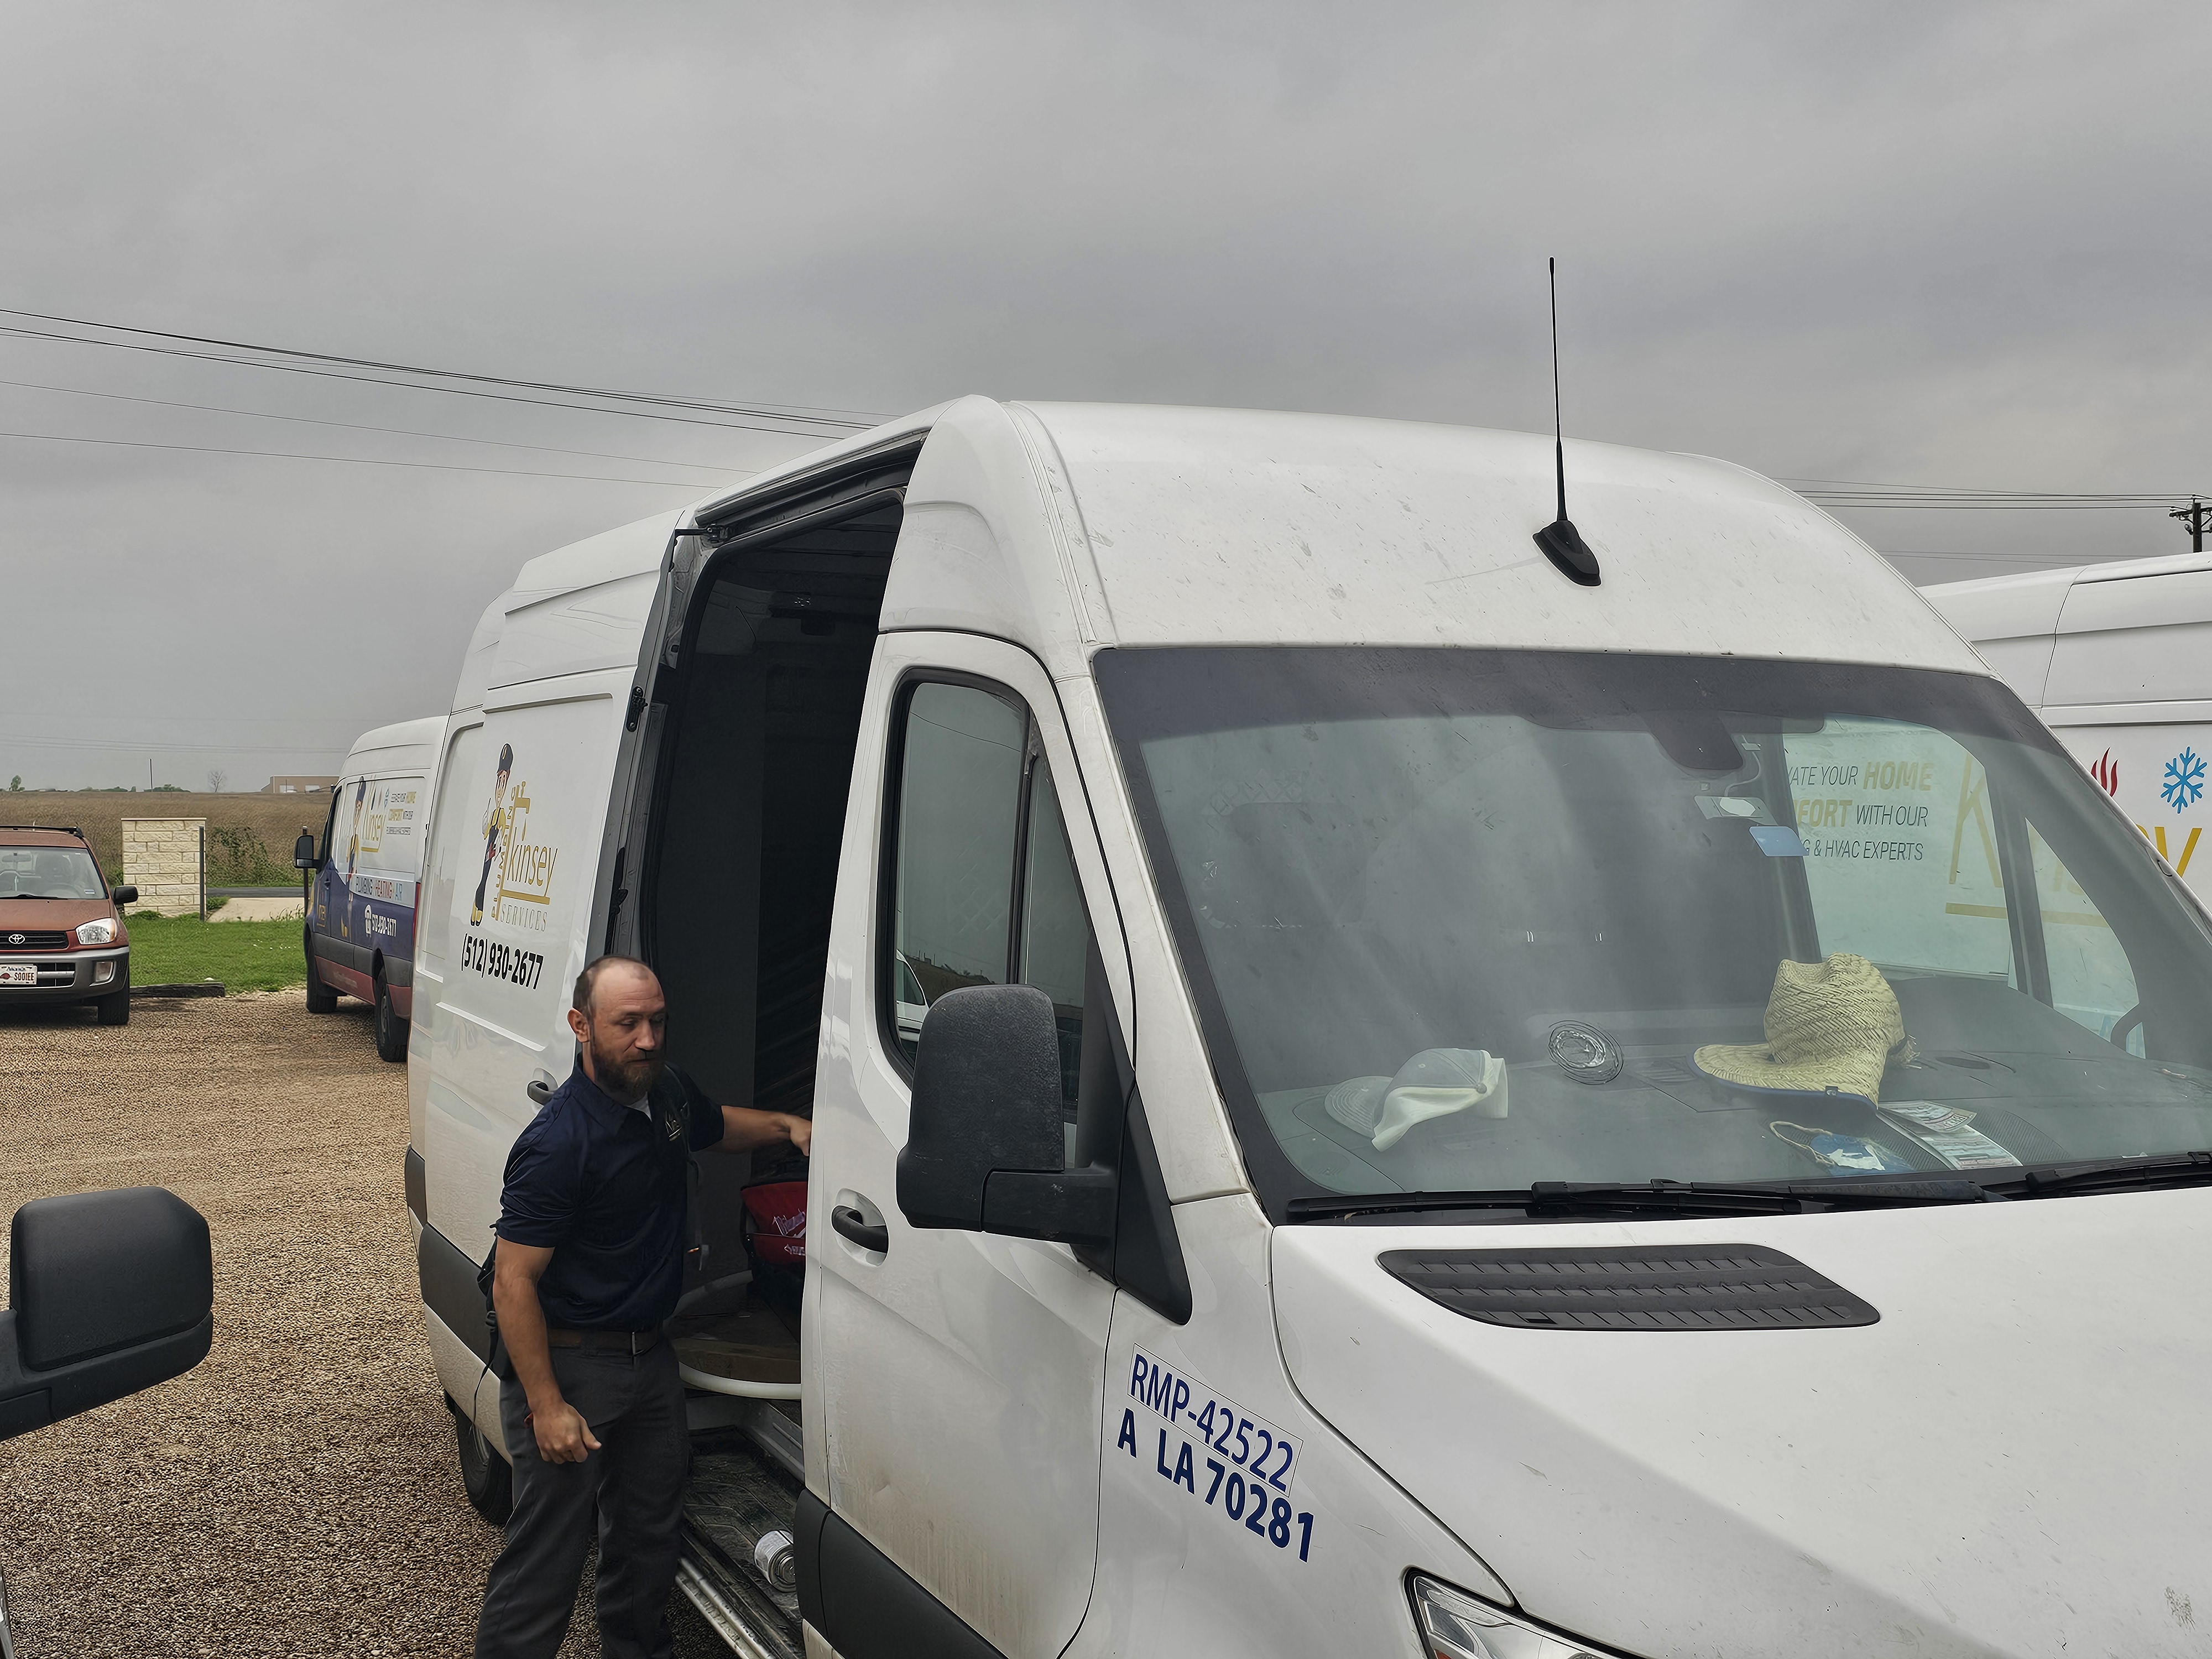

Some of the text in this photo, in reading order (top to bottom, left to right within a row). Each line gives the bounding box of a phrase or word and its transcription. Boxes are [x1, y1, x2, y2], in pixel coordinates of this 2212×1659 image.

[1821, 765, 1858, 785] YOUR
[1863, 761, 1936, 791] HOME
[1856, 805, 1893, 825] WITH
[1896, 806, 1928, 827] OUR
[1814, 839, 1822, 857] &
[1825, 840, 1860, 858] HVAC
[1864, 841, 1923, 860] EXPERTS
[500, 904, 547, 932] SERVICES
[461, 933, 544, 990] (512) 930-2677
[1130, 1353, 1293, 1493] RMP-42522
[1117, 1407, 1314, 1563] A LA 70281
